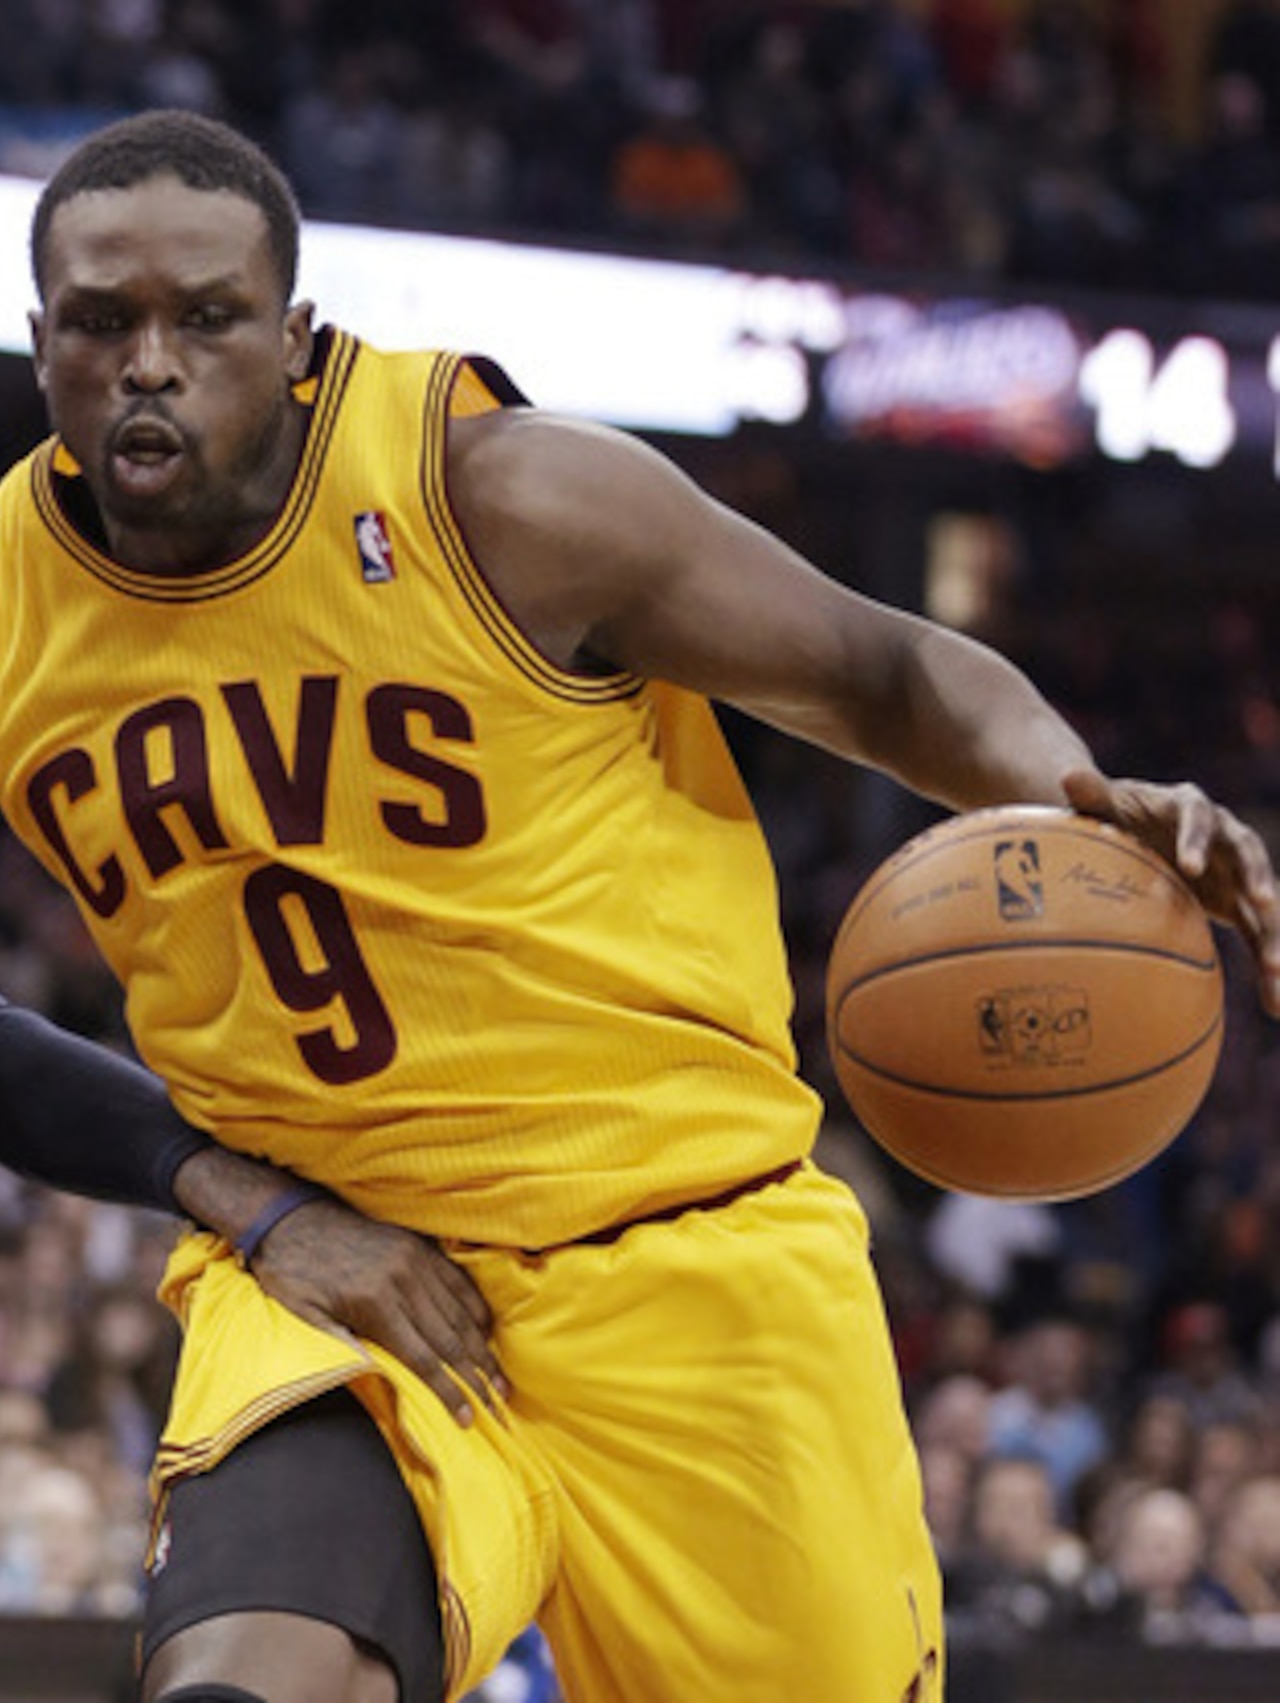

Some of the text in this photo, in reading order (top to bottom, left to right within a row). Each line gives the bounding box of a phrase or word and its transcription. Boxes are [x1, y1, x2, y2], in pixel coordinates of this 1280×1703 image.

[1080, 328, 1236, 468] 14
[27, 674, 487, 919] CAVS
[243, 863, 397, 1085] 9
